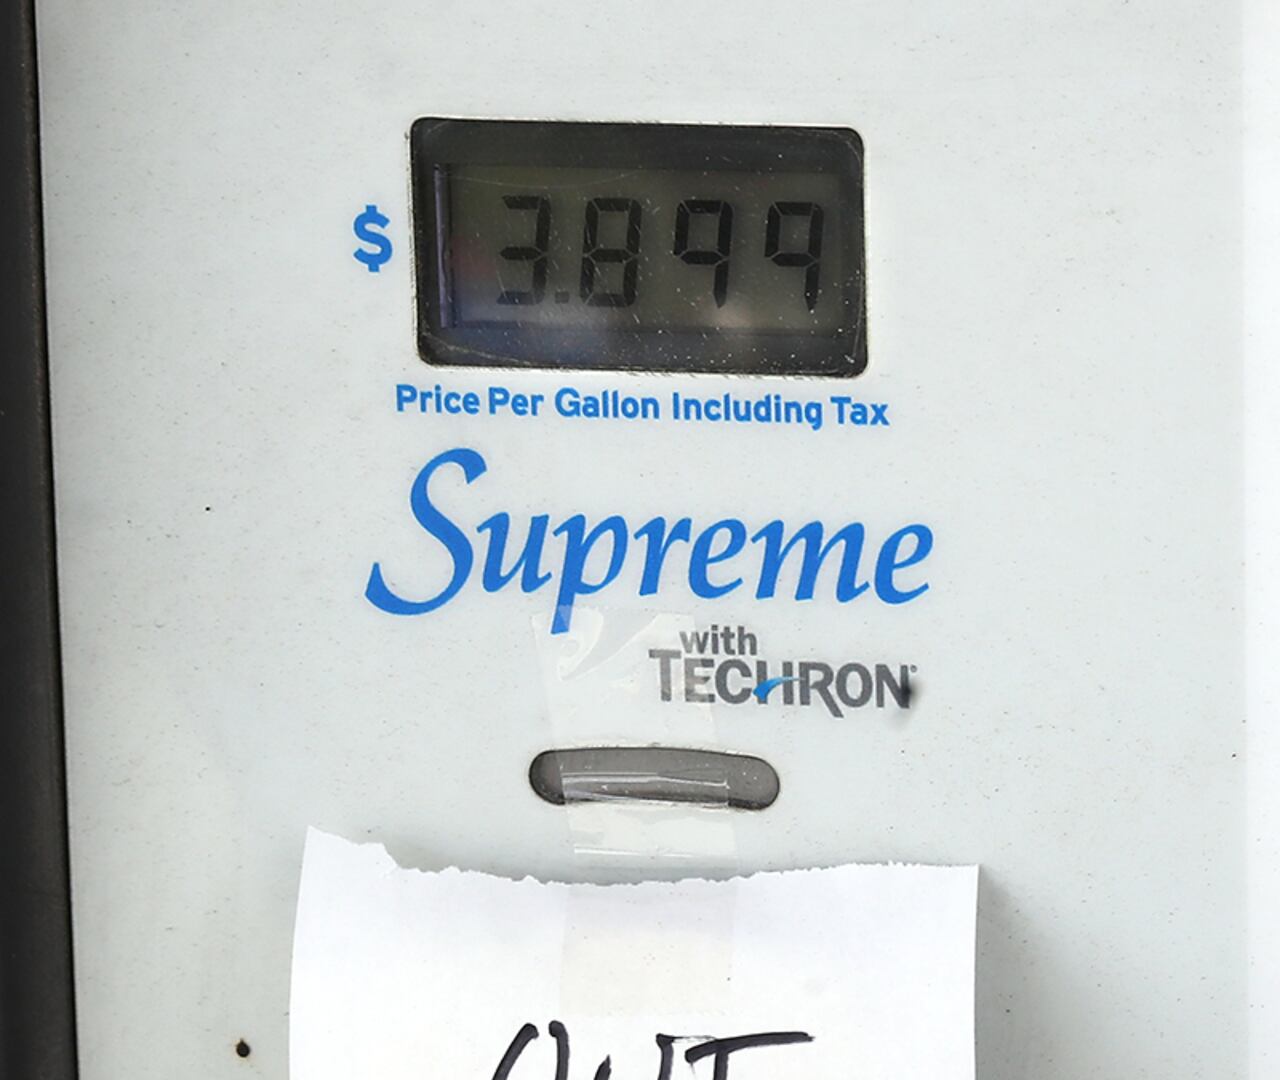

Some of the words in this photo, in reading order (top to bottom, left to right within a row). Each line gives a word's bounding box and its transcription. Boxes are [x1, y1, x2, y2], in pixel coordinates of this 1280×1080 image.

[352, 203, 394, 273] $
[496, 195, 825, 310] 3.899
[395, 383, 481, 416] Price
[487, 385, 545, 417] Per
[554, 386, 661, 421] Gallon
[671, 391, 824, 432] Including
[830, 395, 890, 427] Tax
[363, 447, 935, 636] Supreme
[679, 625, 758, 656] with
